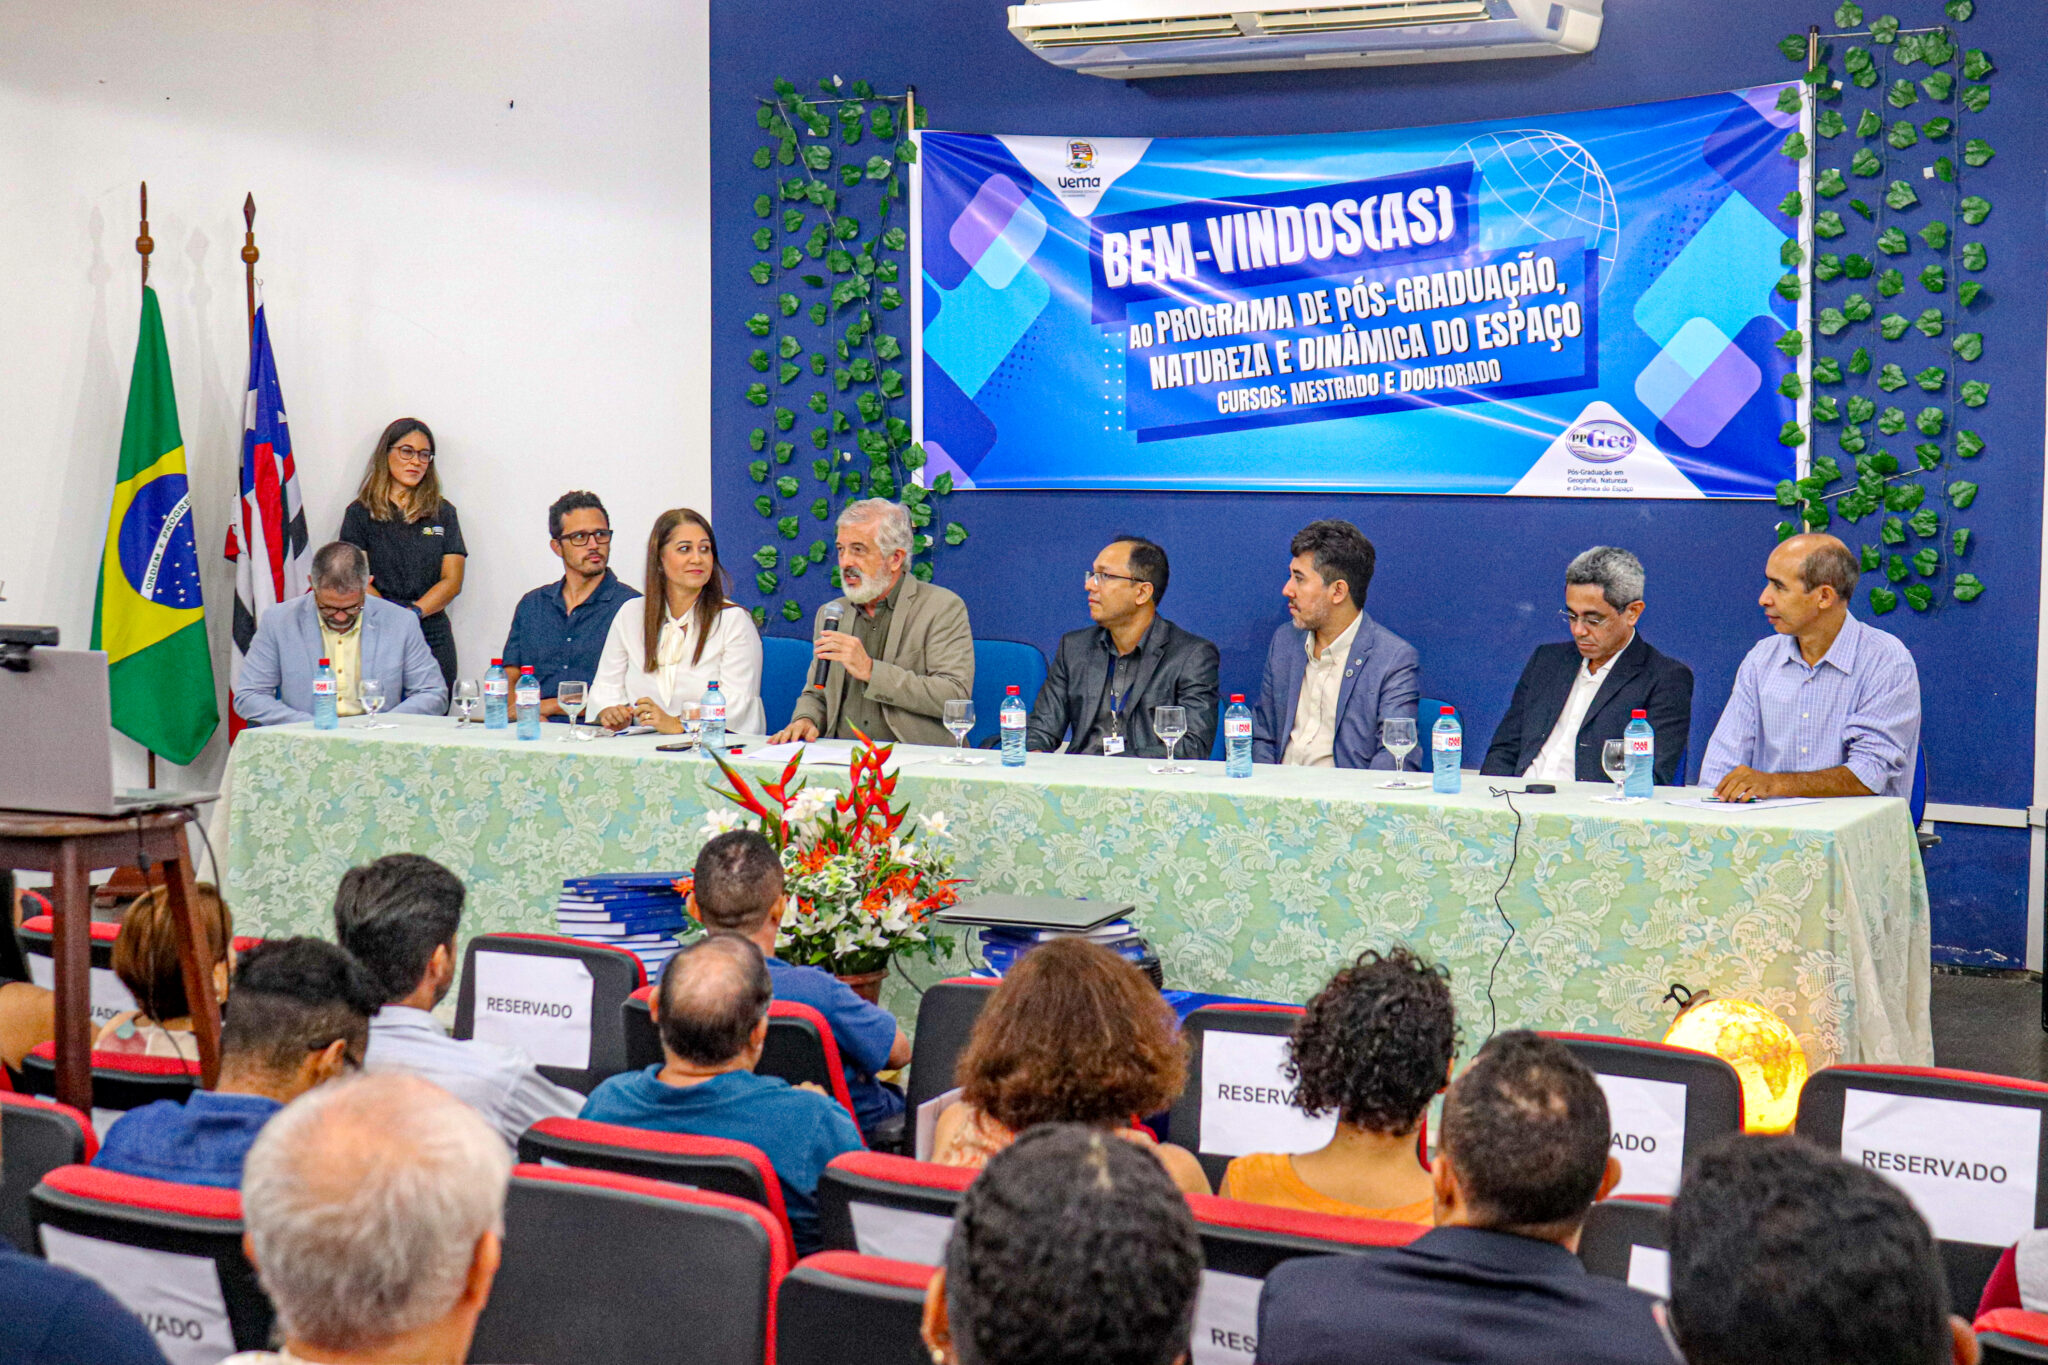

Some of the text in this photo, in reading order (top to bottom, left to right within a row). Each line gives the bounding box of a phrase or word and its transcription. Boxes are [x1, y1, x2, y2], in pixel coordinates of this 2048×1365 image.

[1102, 185, 1456, 289] BEM-VINDOS(AS)
[1130, 251, 1568, 349] AO PROGRAMA DE PÓS-GRADUAÇÃO,
[1149, 301, 1582, 391] NATUREZA E DINÂMICA DO ESPAÇO
[1217, 358, 1503, 414] CURSOS: MESTRADO E DOUTORADO
[145, 552, 162, 590] ORDEM
[162, 496, 191, 539] PROGRE
[487, 996, 573, 1019] RESERVADO
[1218, 1083, 1293, 1106] RESERV
[1862, 1149, 2008, 1184] RESERVADO
